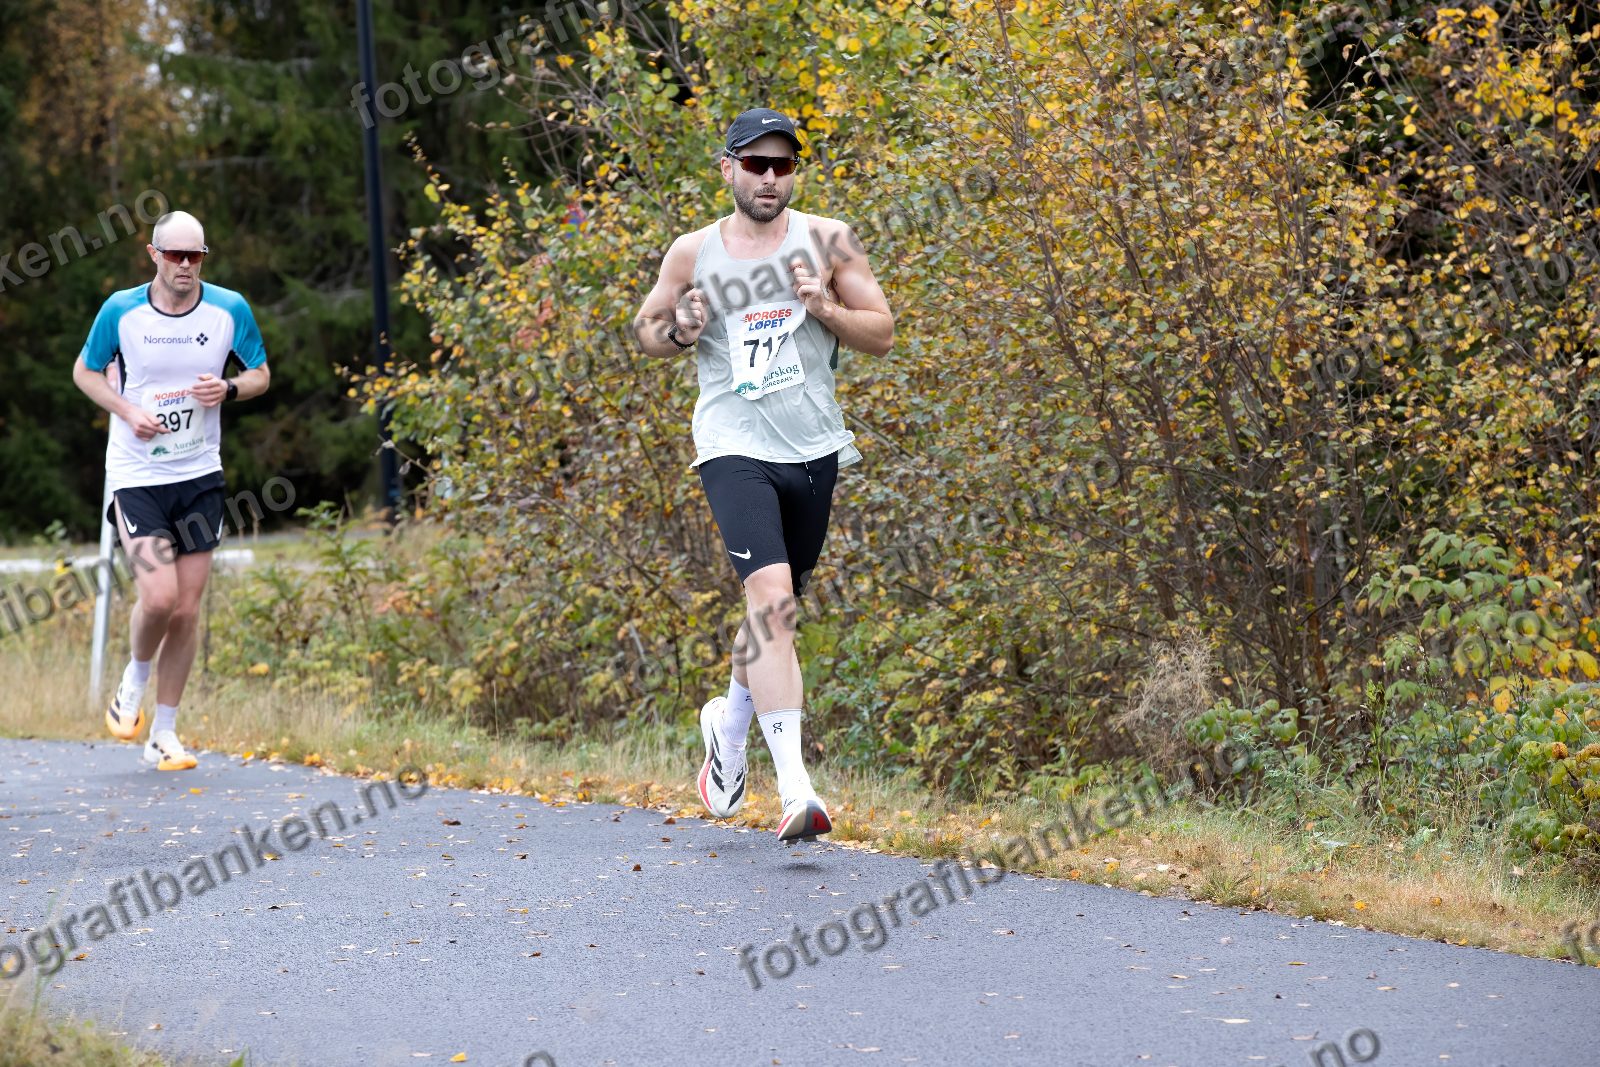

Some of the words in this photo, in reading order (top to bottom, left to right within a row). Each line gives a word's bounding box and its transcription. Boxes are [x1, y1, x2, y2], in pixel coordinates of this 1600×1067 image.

[743, 308, 793, 323] NORGES
[748, 317, 786, 332] LØPET
[144, 335, 193, 344] Norconsult
[156, 408, 194, 434] 397
